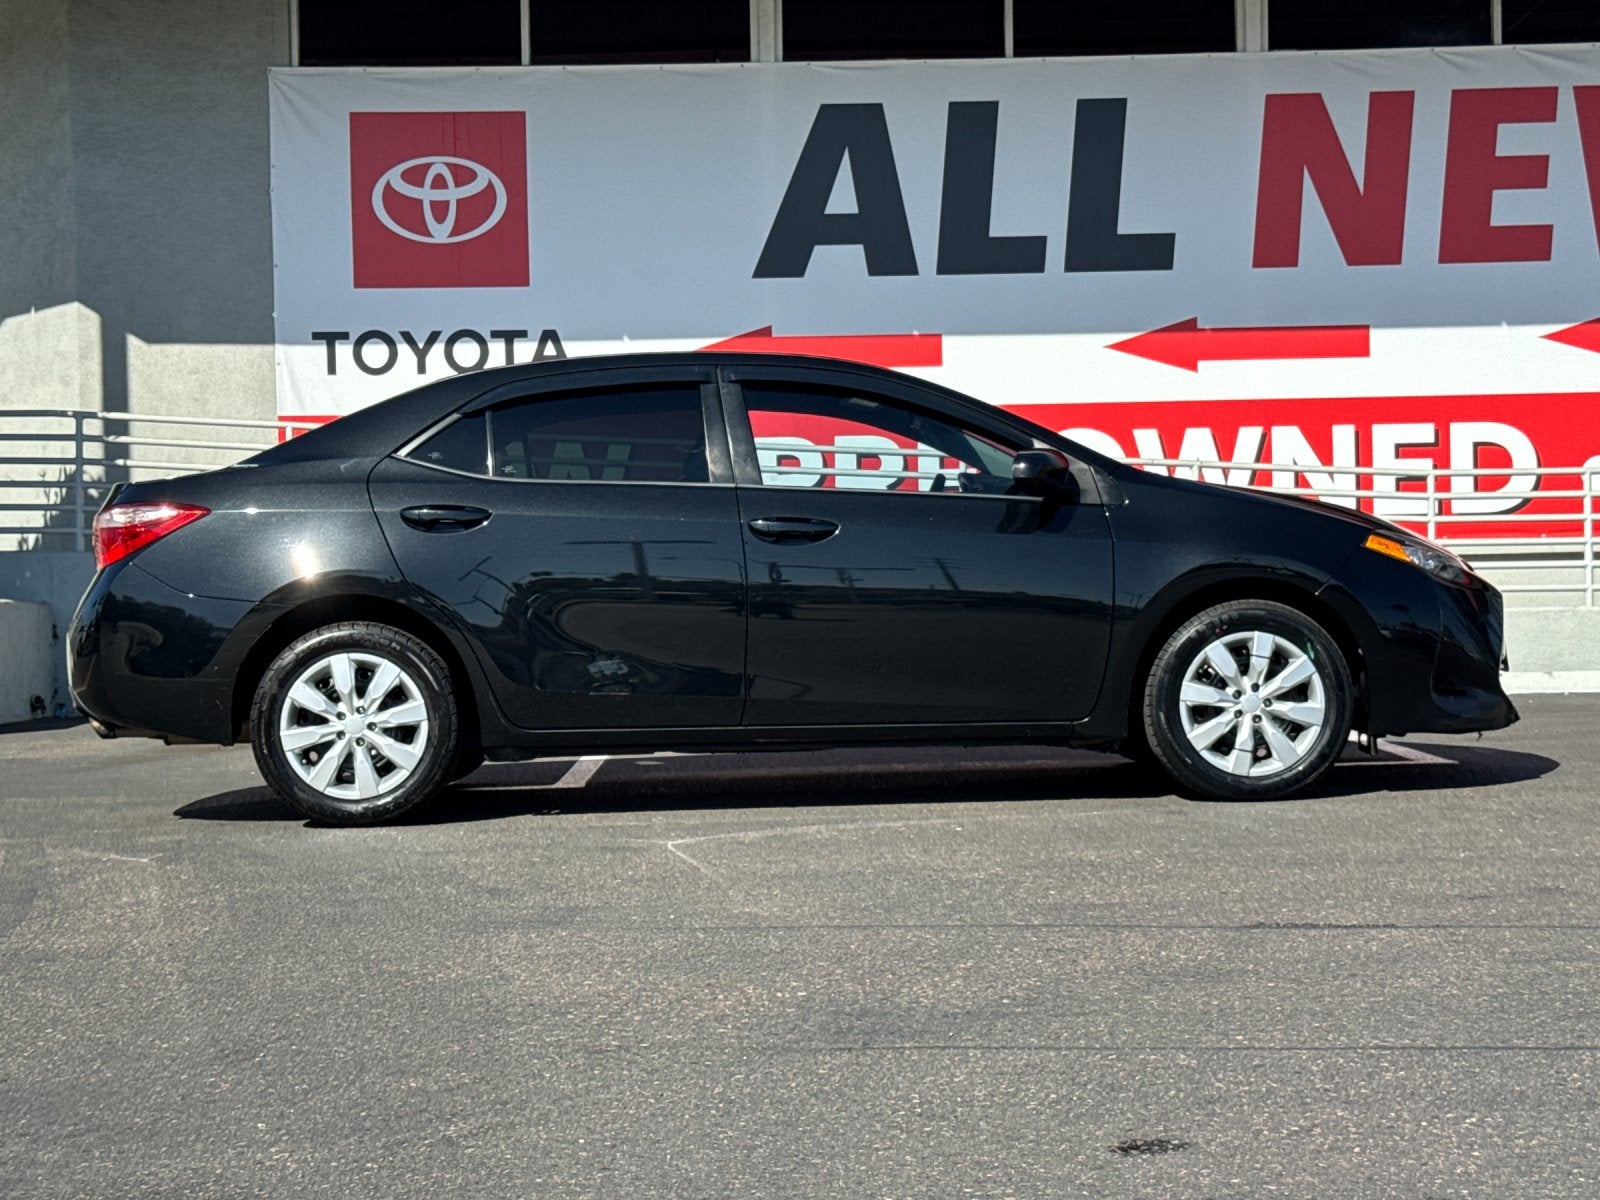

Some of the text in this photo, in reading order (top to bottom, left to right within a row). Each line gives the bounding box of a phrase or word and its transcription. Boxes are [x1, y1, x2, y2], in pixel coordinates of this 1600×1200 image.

[752, 85, 1600, 279] ALL NE
[311, 328, 568, 376] TOYOTA
